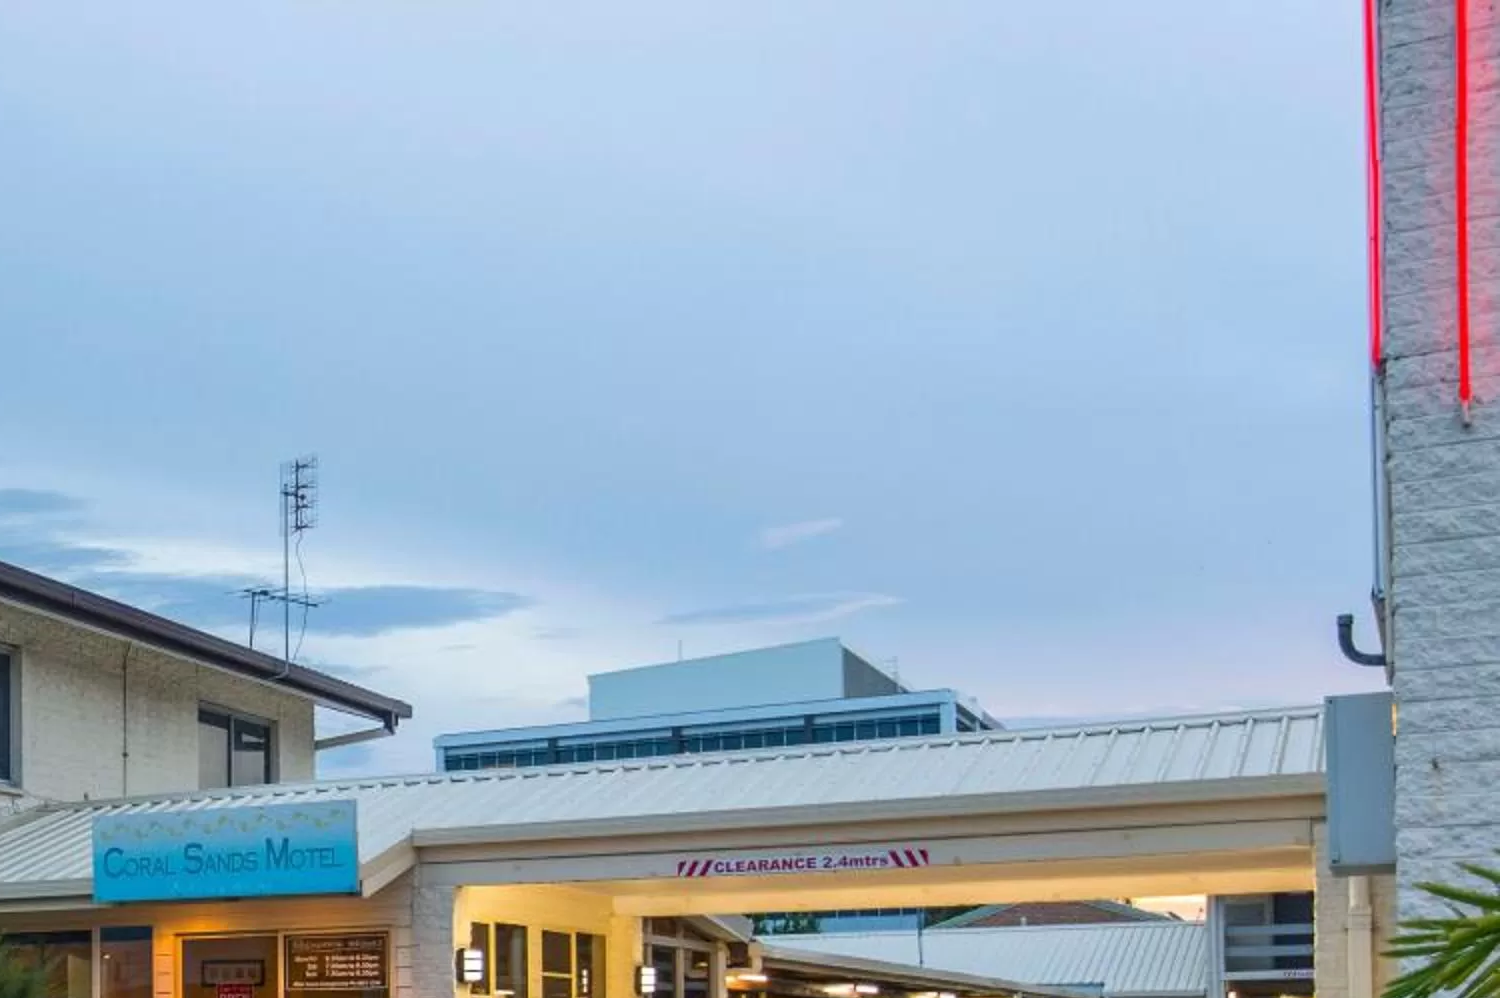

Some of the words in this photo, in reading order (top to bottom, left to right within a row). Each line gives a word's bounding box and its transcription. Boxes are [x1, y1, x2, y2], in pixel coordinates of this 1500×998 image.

[103, 847, 177, 878] CORAL
[183, 842, 259, 874] SANDS
[264, 837, 344, 871] MOTEL
[713, 856, 817, 873] CLEARANCE
[822, 854, 888, 870] 2.4mtrs
